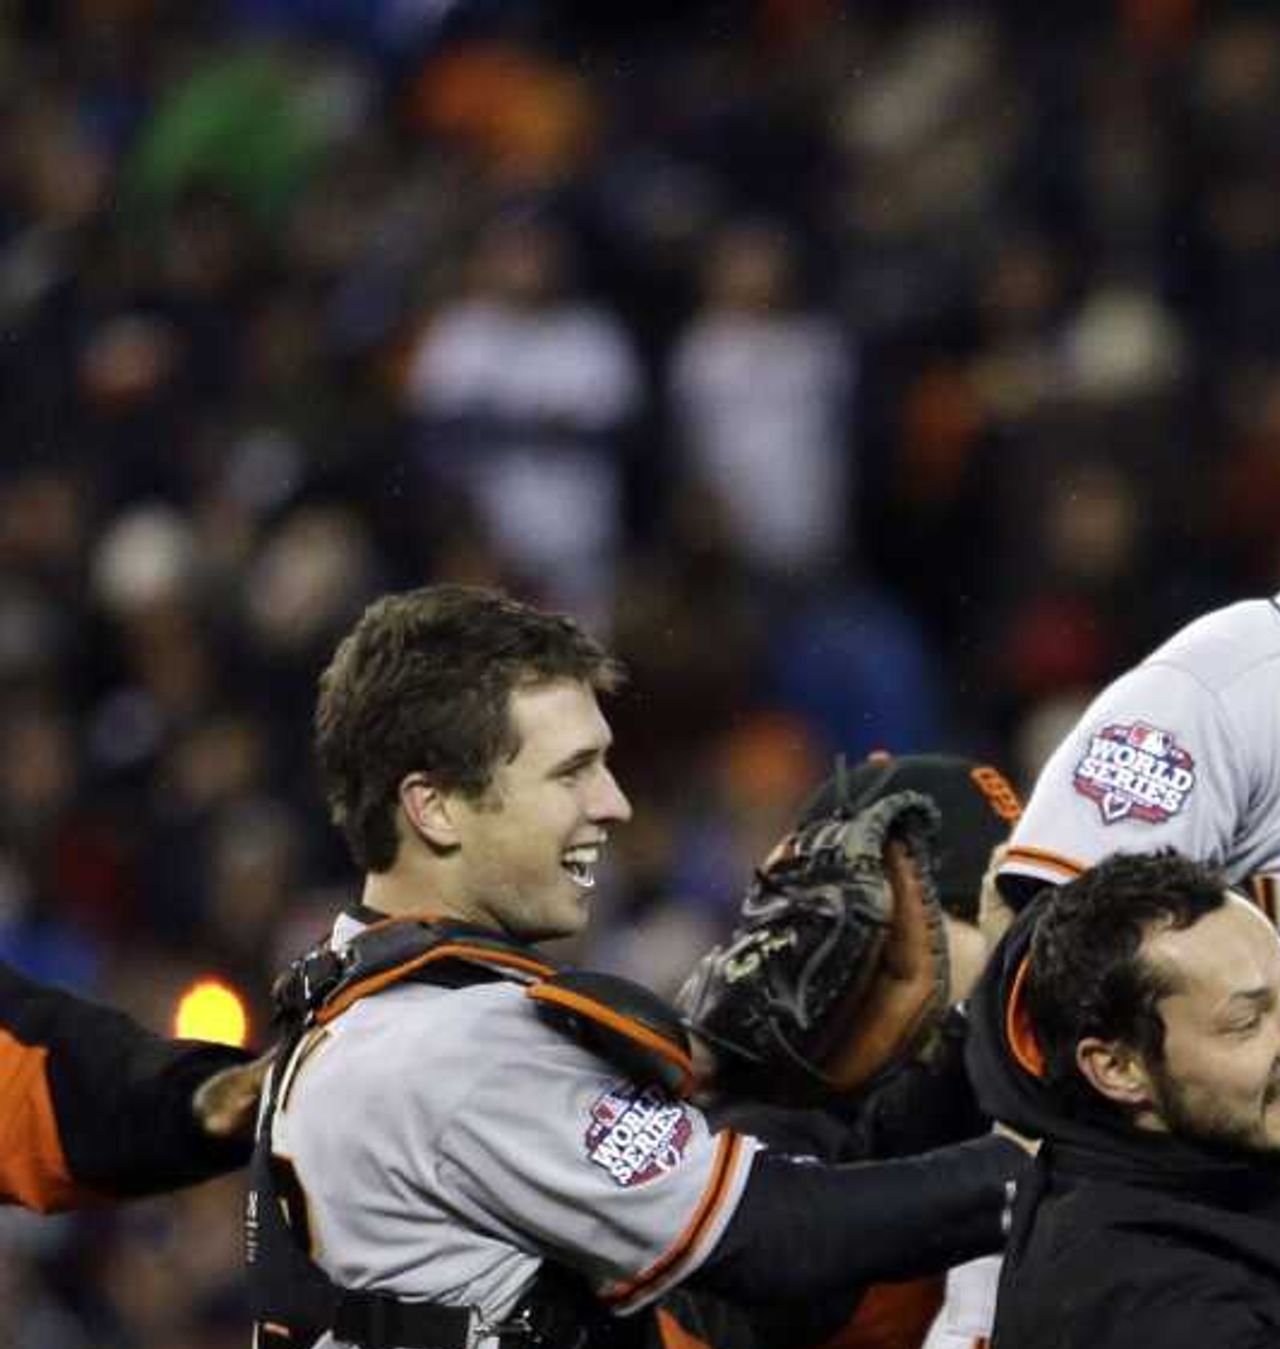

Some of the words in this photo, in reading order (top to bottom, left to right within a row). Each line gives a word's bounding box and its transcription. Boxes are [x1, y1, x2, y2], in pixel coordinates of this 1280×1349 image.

[1078, 756, 1183, 812] SERIES
[1089, 736, 1193, 792] WORLD
[609, 1107, 682, 1185] SERIES
